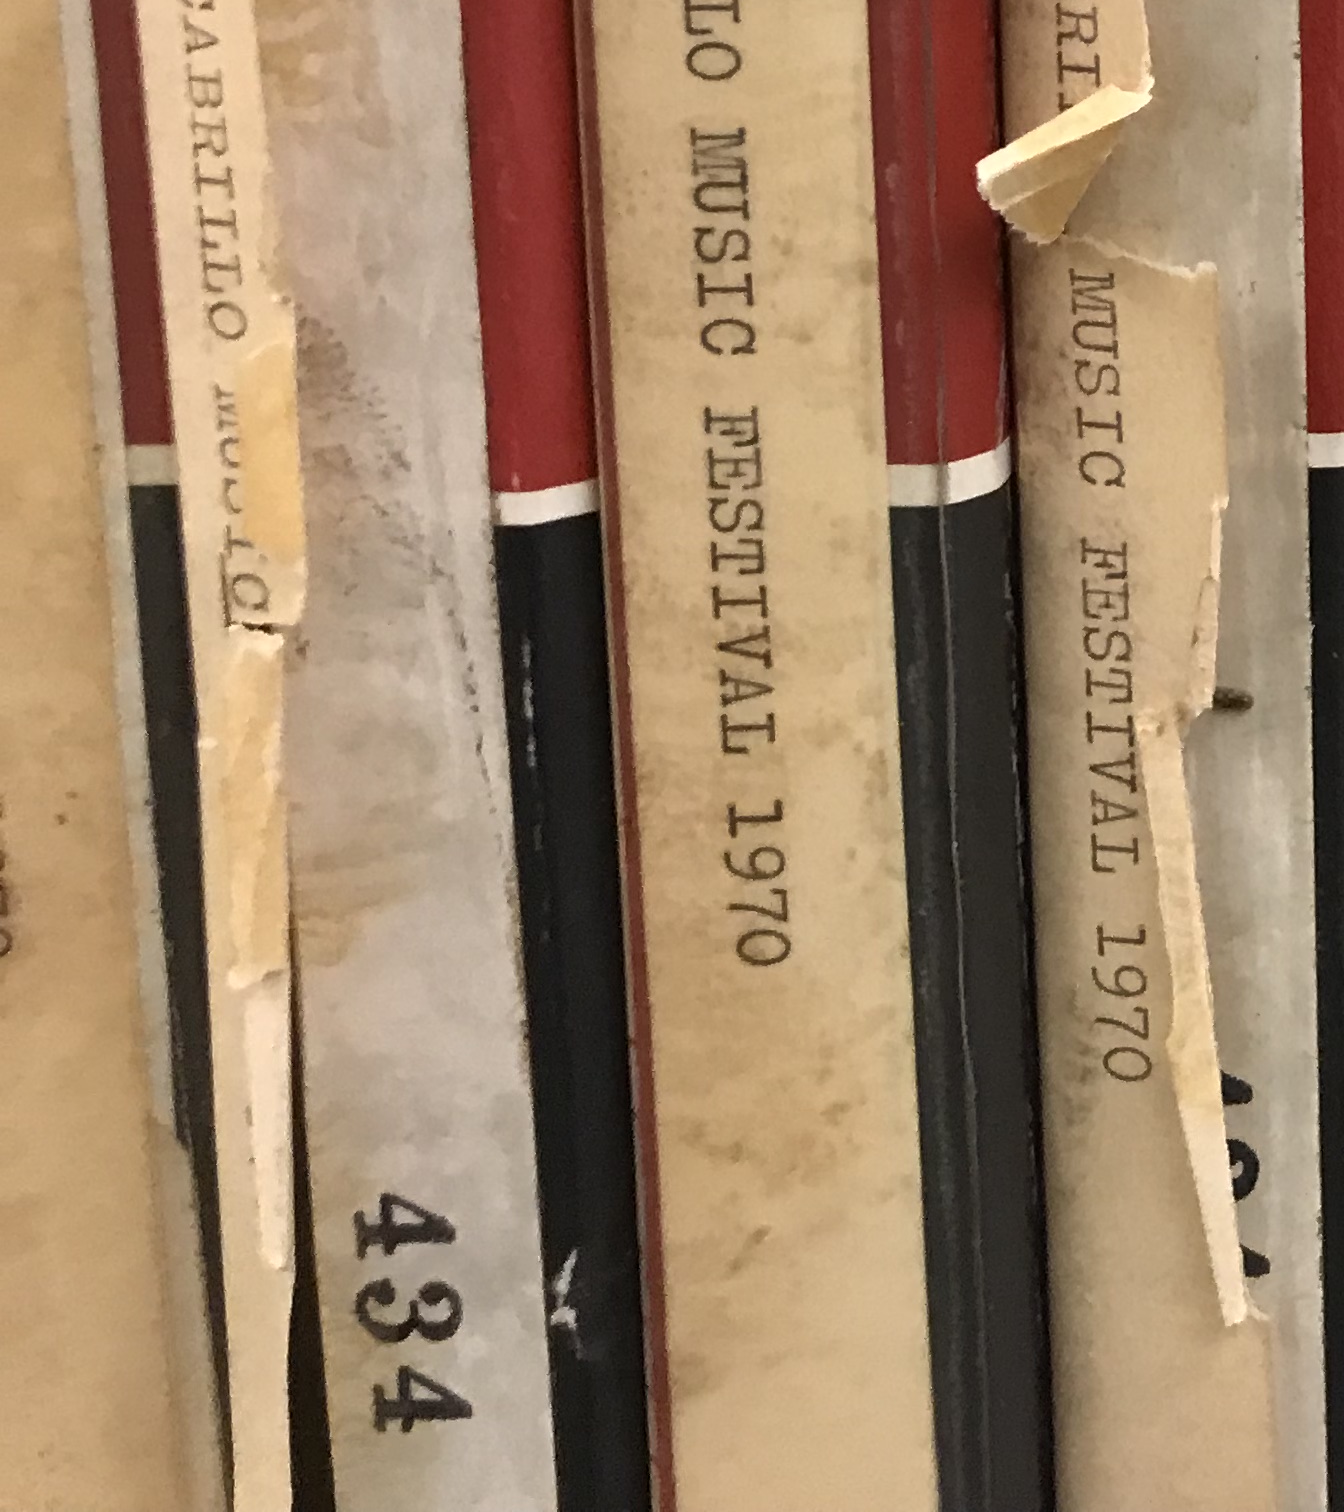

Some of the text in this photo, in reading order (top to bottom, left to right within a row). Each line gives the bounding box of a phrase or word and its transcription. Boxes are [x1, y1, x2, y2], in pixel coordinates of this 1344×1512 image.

[687, 126, 758, 357] MUSIC
[1068, 267, 1126, 490] MUSIC
[703, 405, 778, 757] FESTIVAL
[1078, 536, 1142, 876] FESTIVAL
[723, 800, 792, 969] 1970
[1091, 924, 1152, 1084] 1970
[353, 1192, 474, 1436] 434
